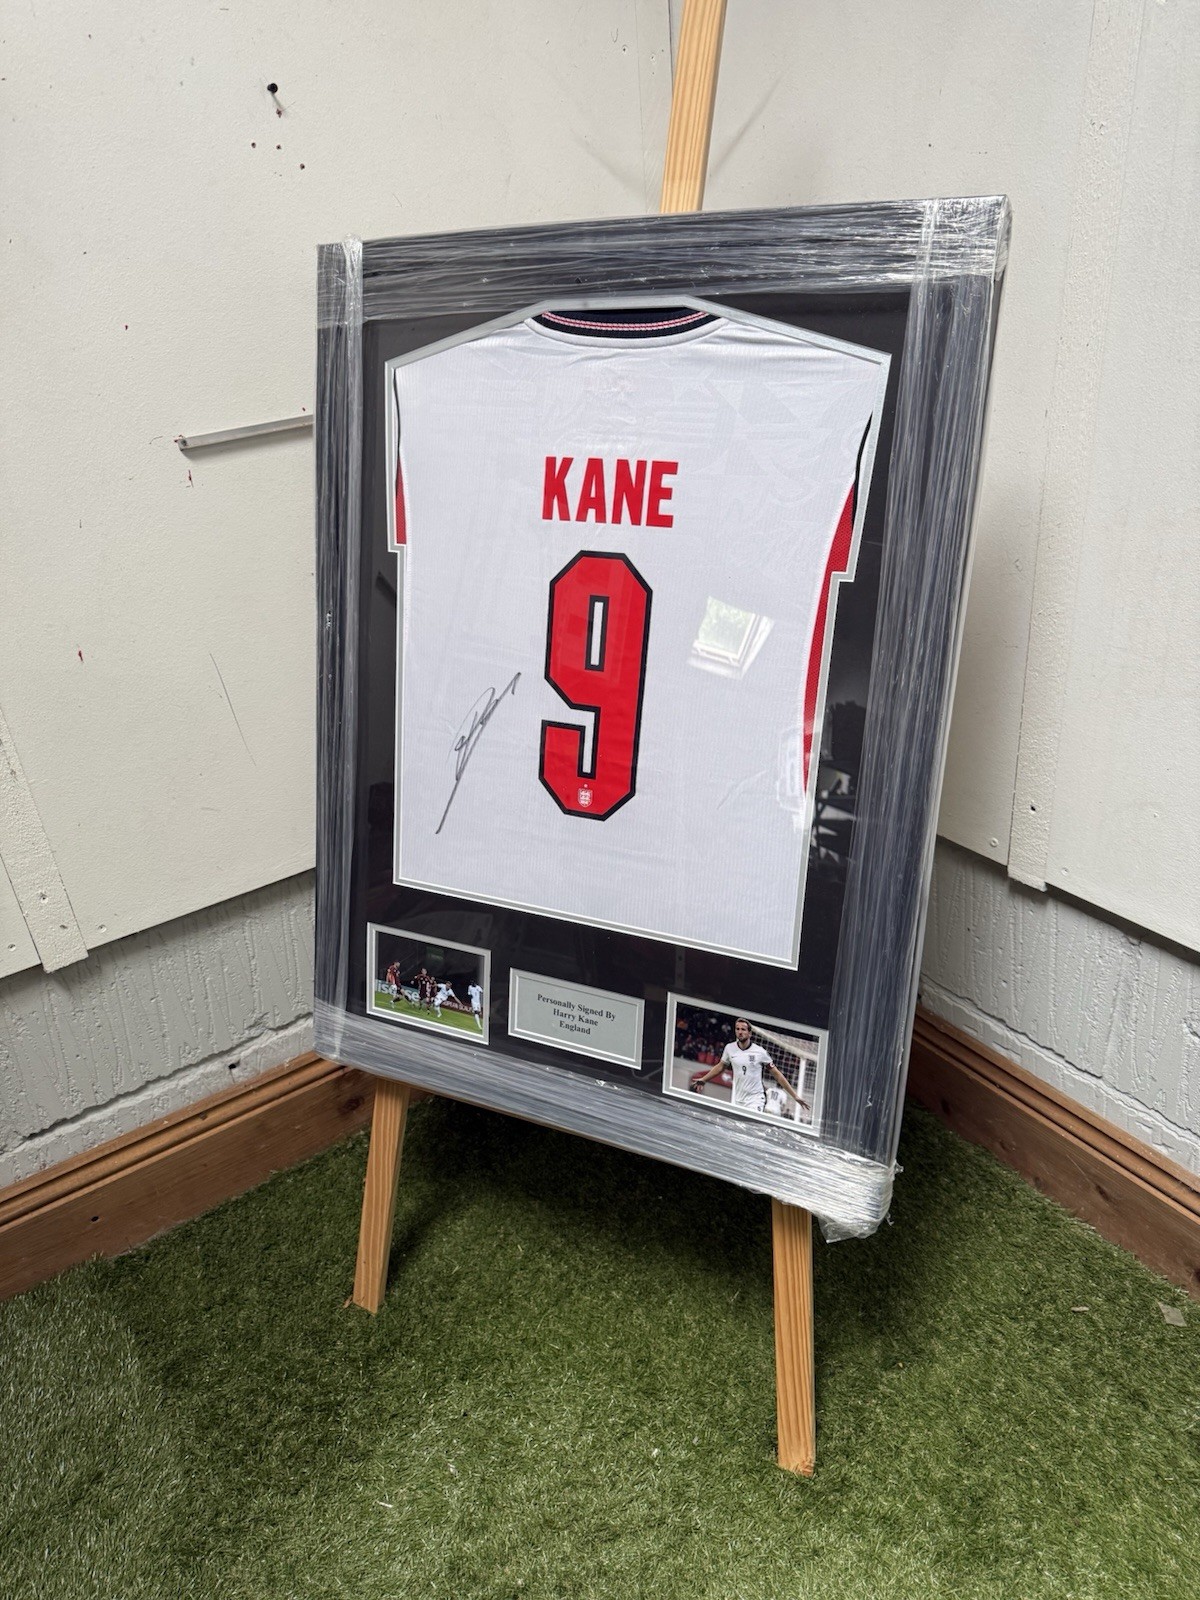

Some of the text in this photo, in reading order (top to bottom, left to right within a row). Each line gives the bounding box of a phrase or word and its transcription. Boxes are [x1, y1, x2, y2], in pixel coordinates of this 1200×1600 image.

[542, 456, 678, 528] KANE
[538, 550, 653, 822] 9
[537, 993, 616, 1021] Personally Signed By
[553, 1008, 599, 1026] Harry Kane
[559, 1020, 591, 1035] England
[742, 1065, 747, 1075] 9
[770, 1090, 779, 1101] 10
